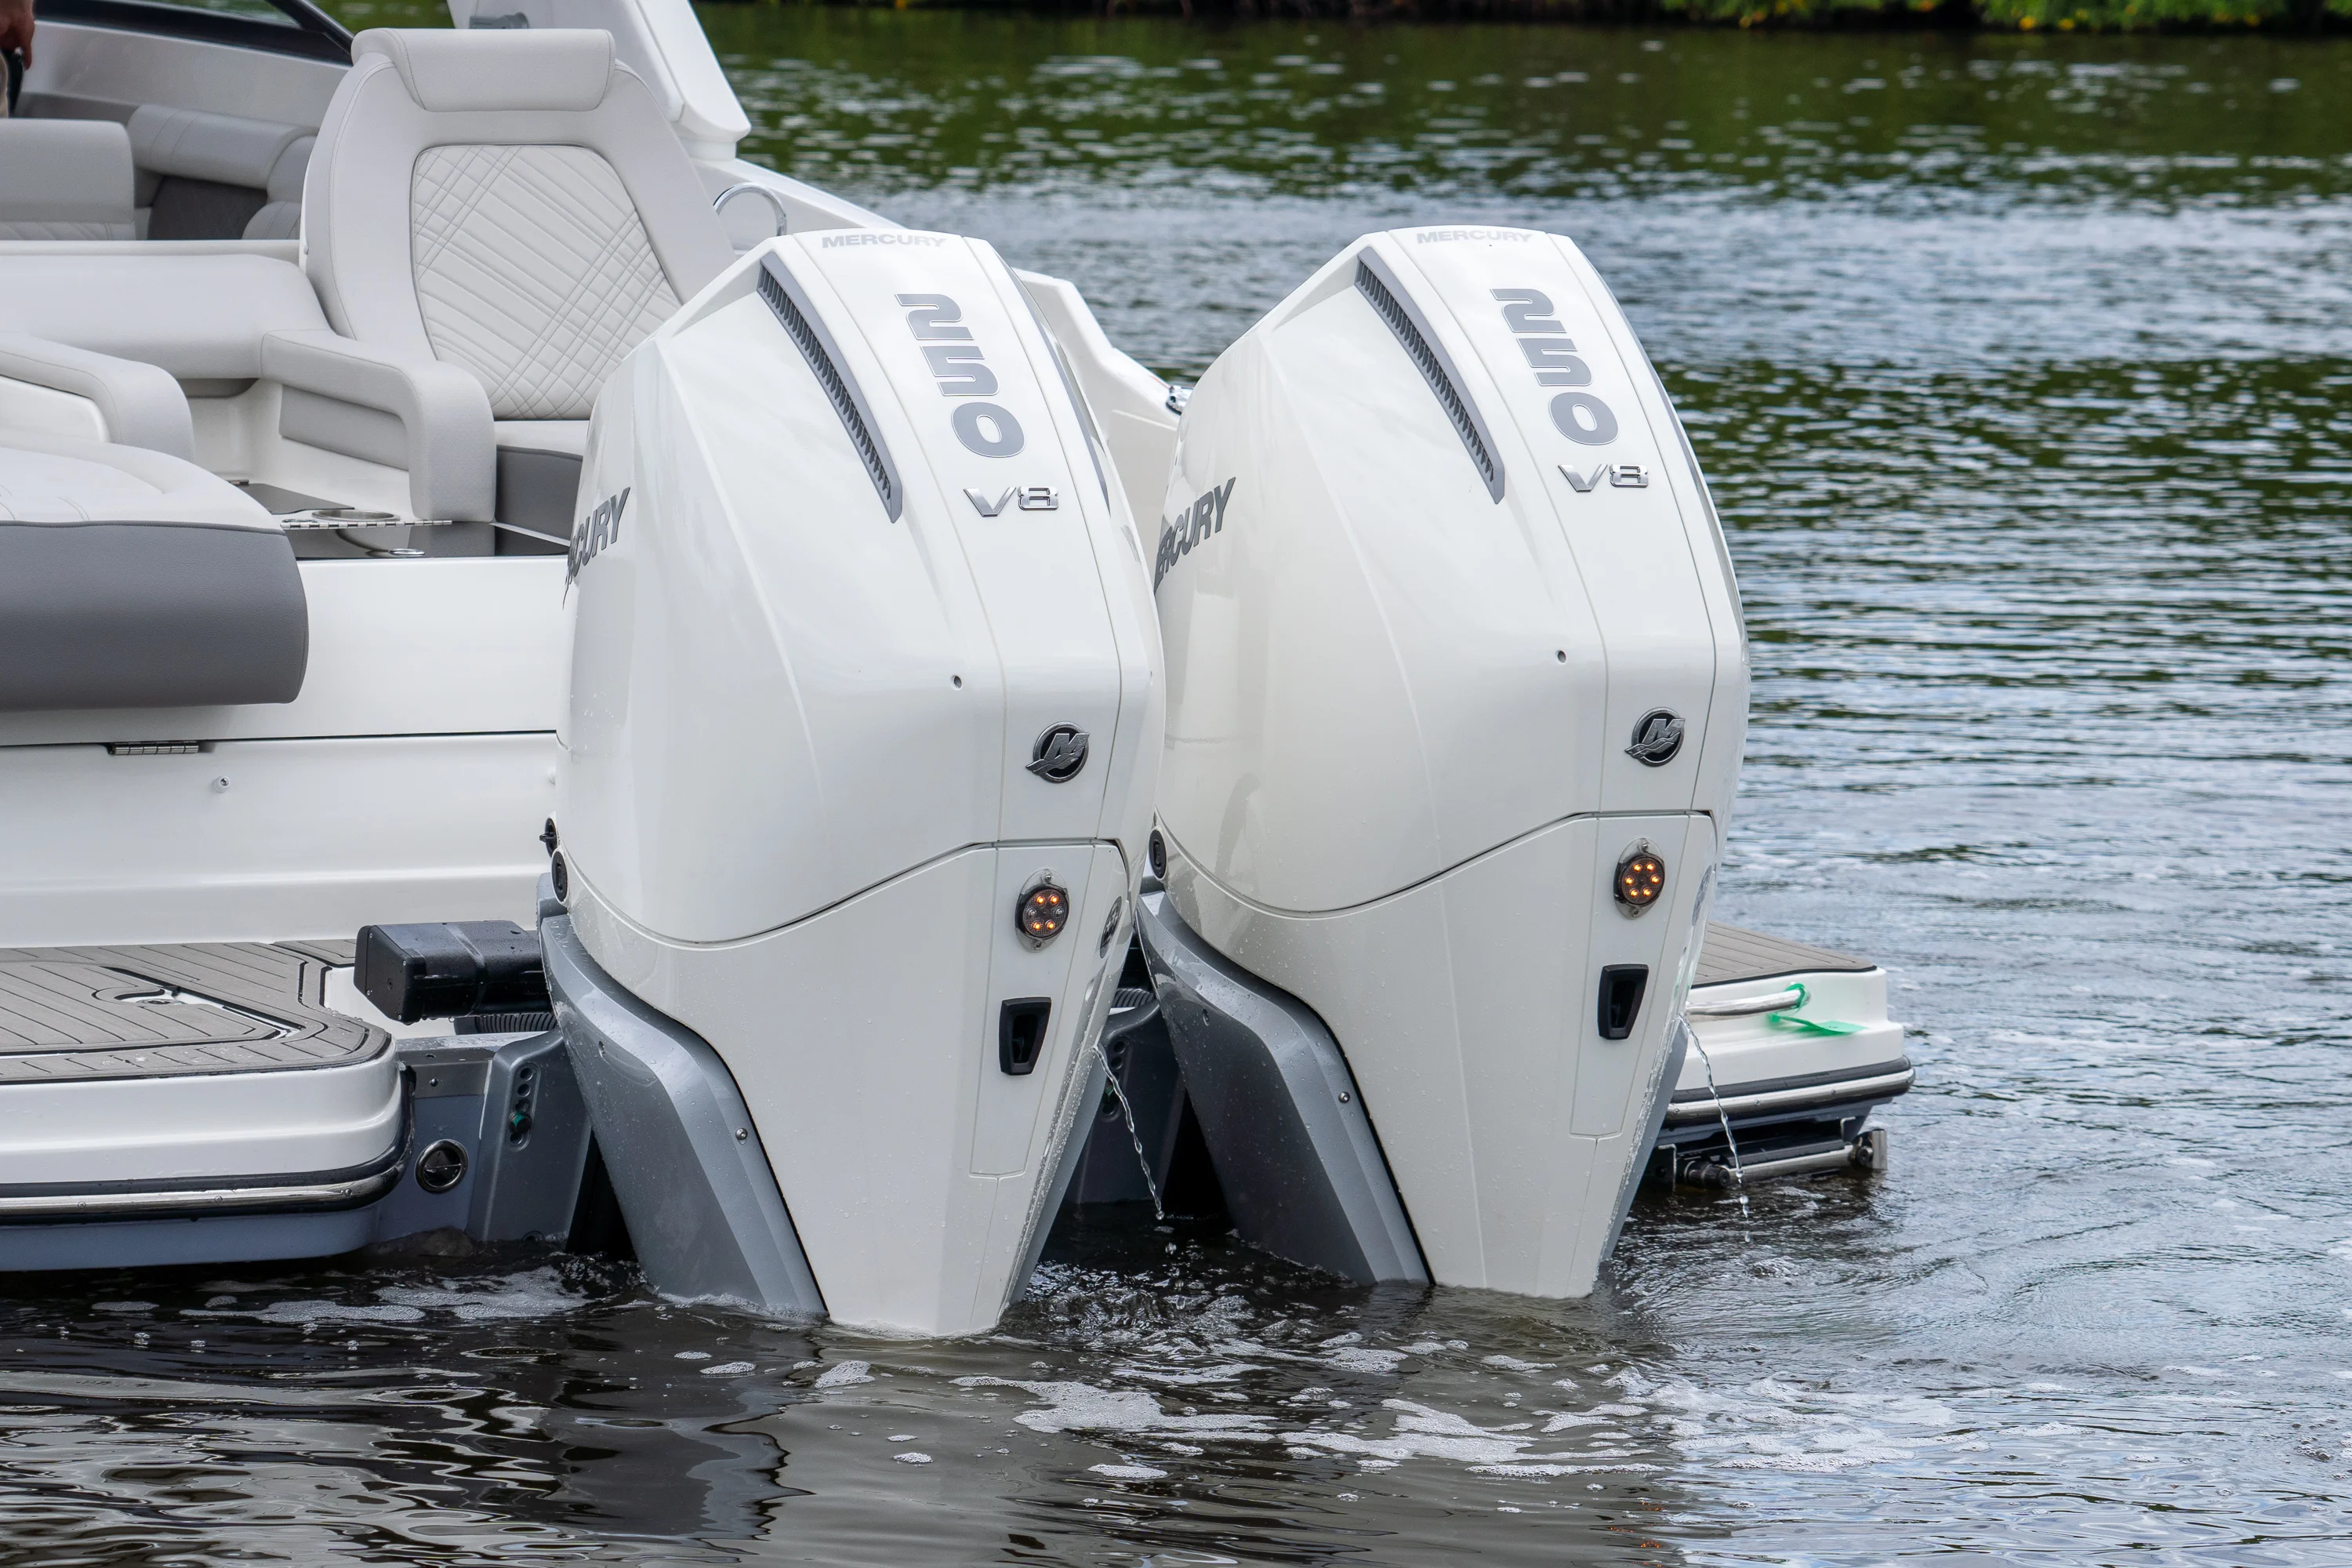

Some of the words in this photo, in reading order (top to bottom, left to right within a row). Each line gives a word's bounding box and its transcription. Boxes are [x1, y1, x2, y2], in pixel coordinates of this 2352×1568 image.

[822, 234, 946, 249] MERCURY
[1417, 230, 1533, 245] MERCURY
[895, 293, 1025, 459] 250
[1490, 288, 1619, 446] 250
[1557, 463, 1649, 492] V8
[963, 486, 1058, 518] V8
